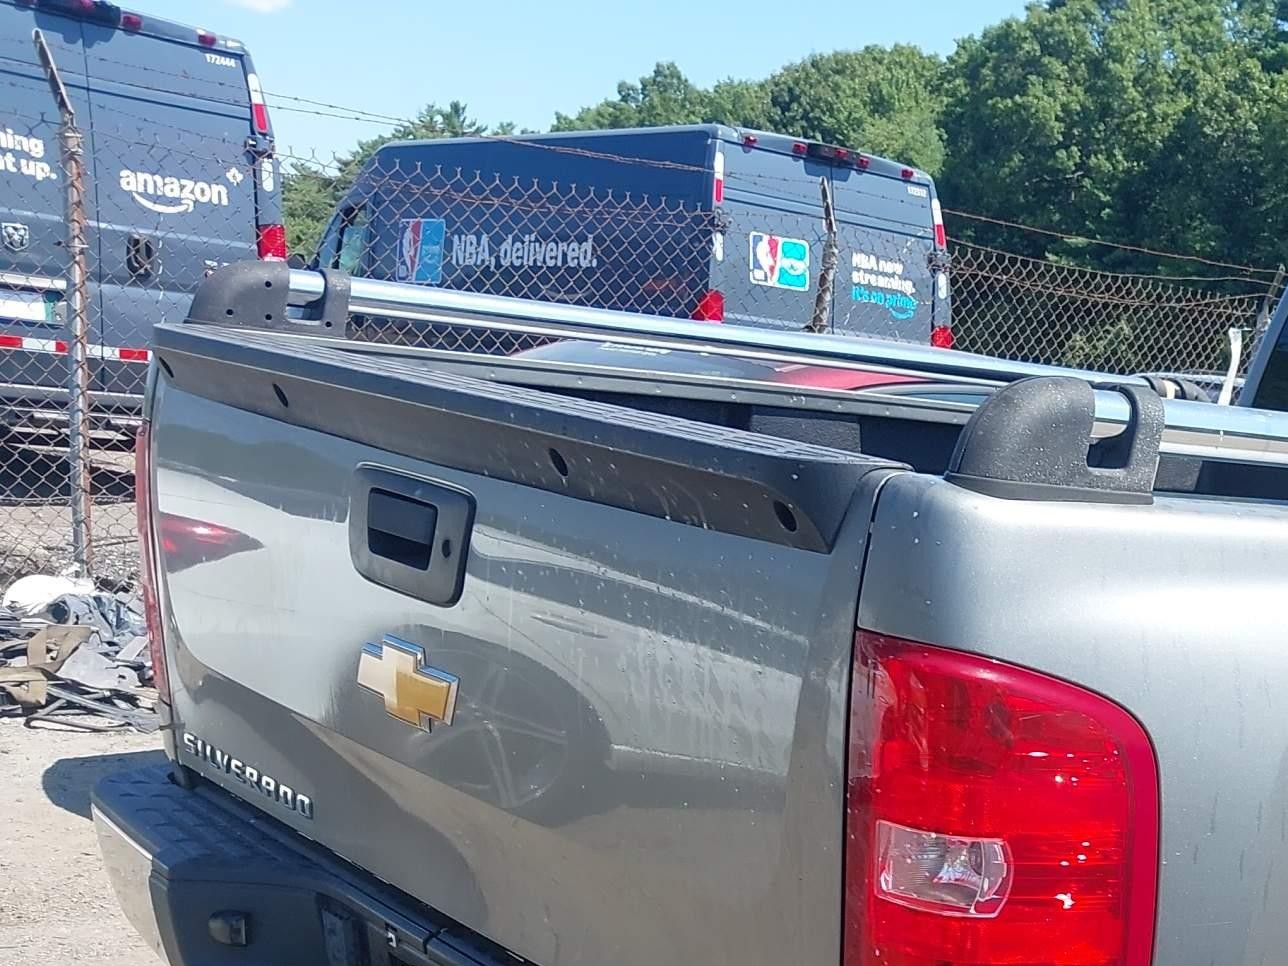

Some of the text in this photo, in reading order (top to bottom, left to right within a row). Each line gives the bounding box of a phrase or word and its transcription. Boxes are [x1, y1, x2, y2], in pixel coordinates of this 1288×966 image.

[20, 159, 58, 180] up.
[119, 168, 229, 206] amazon
[452, 234, 495, 271] NBA,
[500, 234, 598, 268] delivered.
[852, 251, 878, 271] NBA
[852, 269, 916, 295] streaming.
[183, 732, 314, 820] SILVERADO
